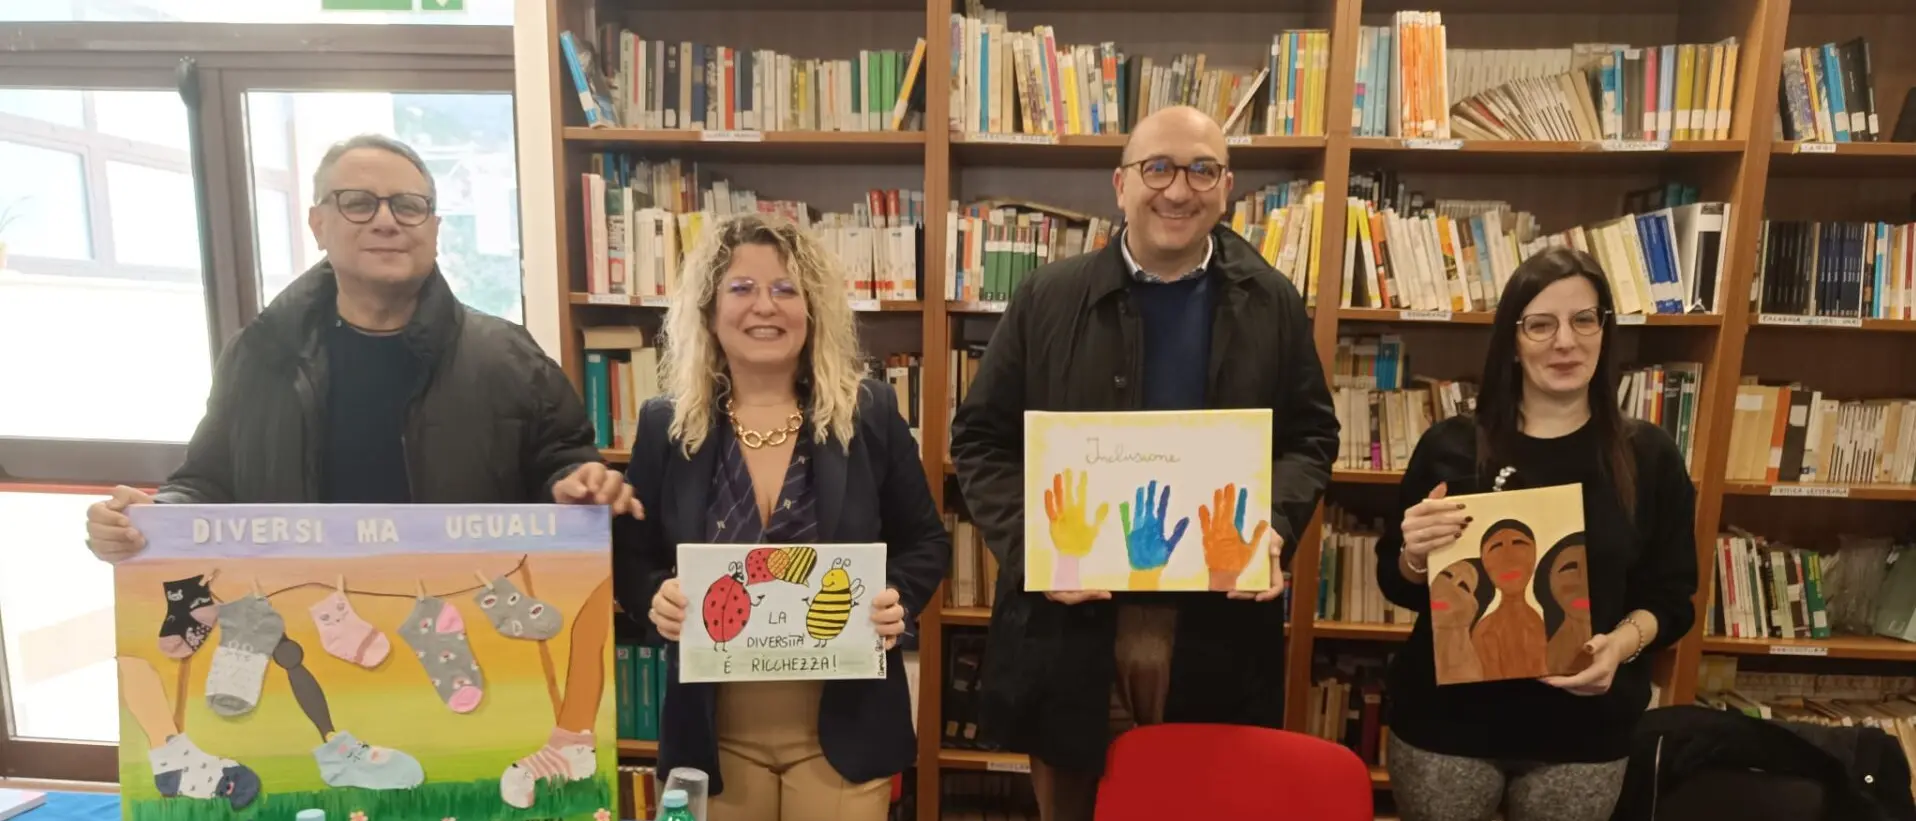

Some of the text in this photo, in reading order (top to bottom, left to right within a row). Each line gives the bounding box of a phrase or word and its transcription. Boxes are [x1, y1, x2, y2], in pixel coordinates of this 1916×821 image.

[193, 512, 557, 544] DIVERSI MA UGUALI
[768, 611, 787, 624] LA
